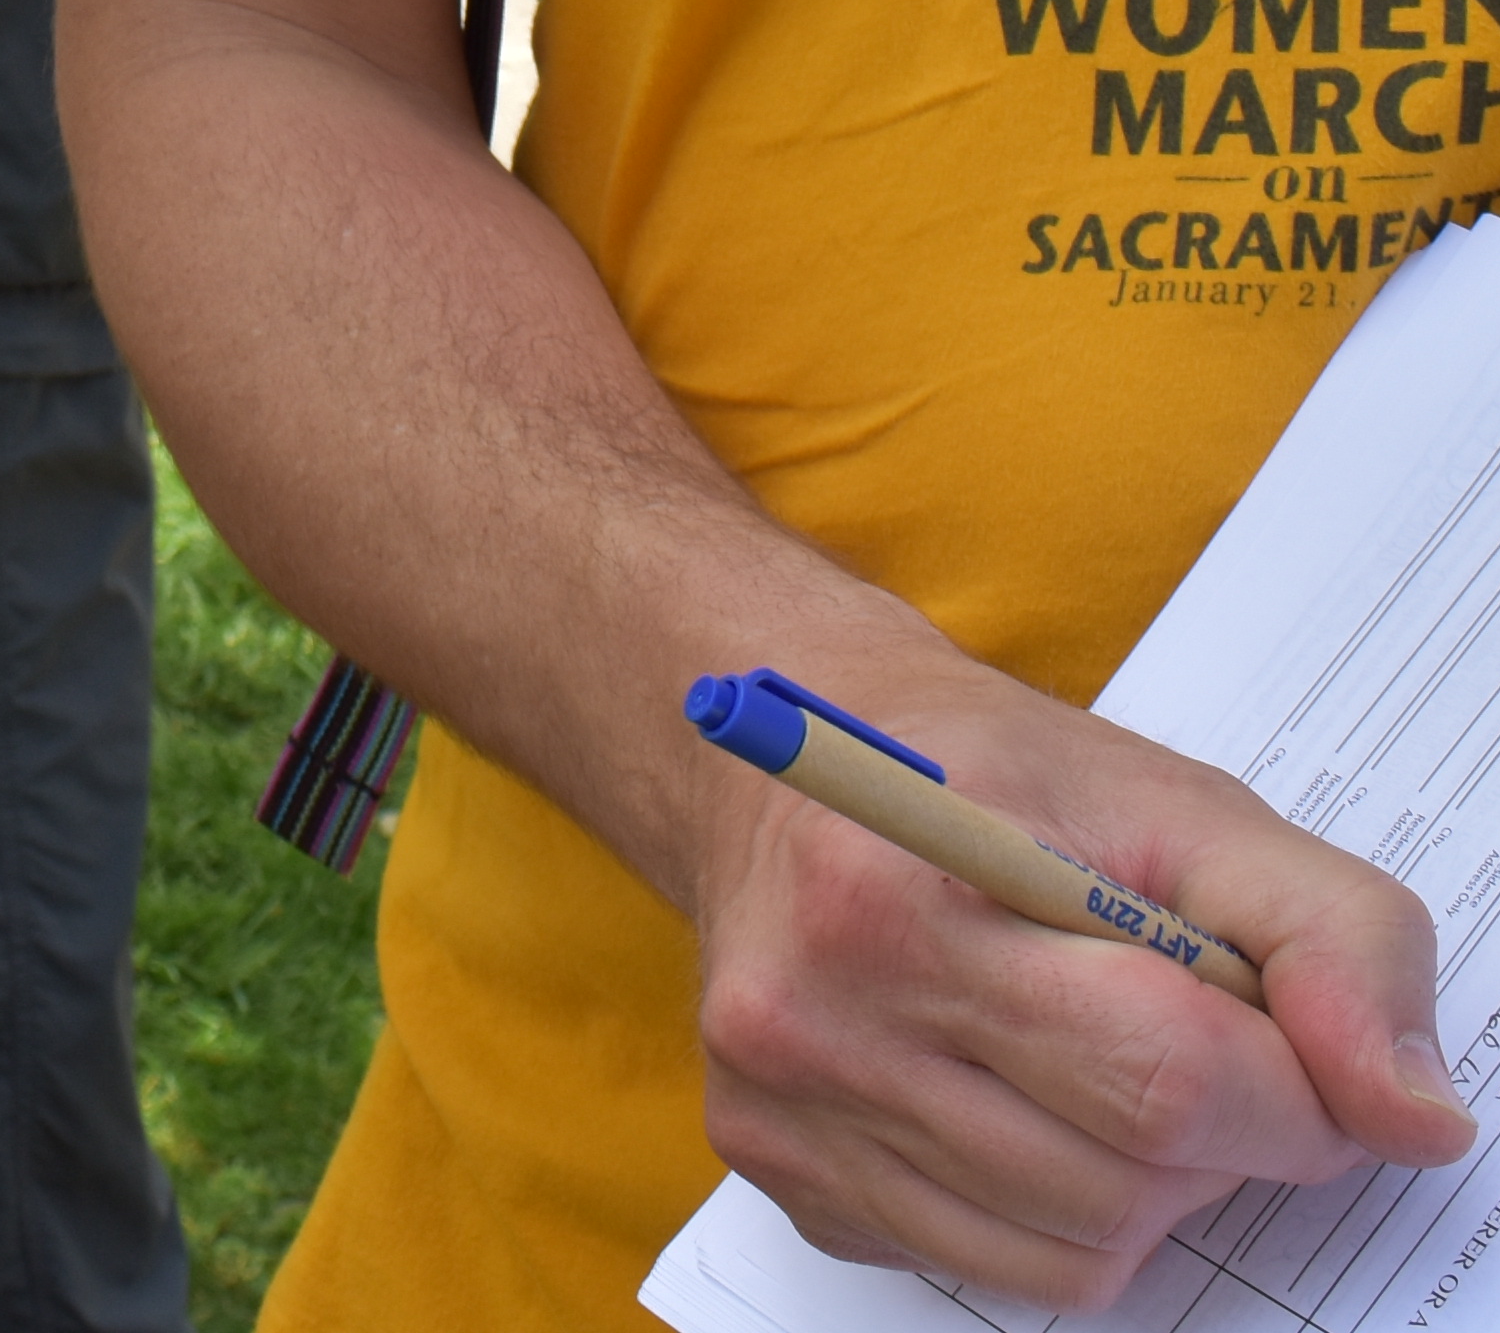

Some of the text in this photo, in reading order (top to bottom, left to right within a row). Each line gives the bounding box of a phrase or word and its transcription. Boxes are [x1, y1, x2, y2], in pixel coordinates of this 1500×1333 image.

[1262, 162, 1350, 205] on
[1107, 267, 1280, 318] January
[1265, 747, 1286, 767] City
[1295, 767, 1330, 807] Address
[1300, 773, 1342, 822] Residence
[1346, 786, 1367, 806] City
[1377, 807, 1413, 848] Address
[1383, 813, 1426, 864] Residence
[1431, 826, 1452, 848] City
[1445, 848, 1500, 918] Address Only
[1085, 885, 1203, 967] AFT 2279
[1423, 1273, 1459, 1309] OR
